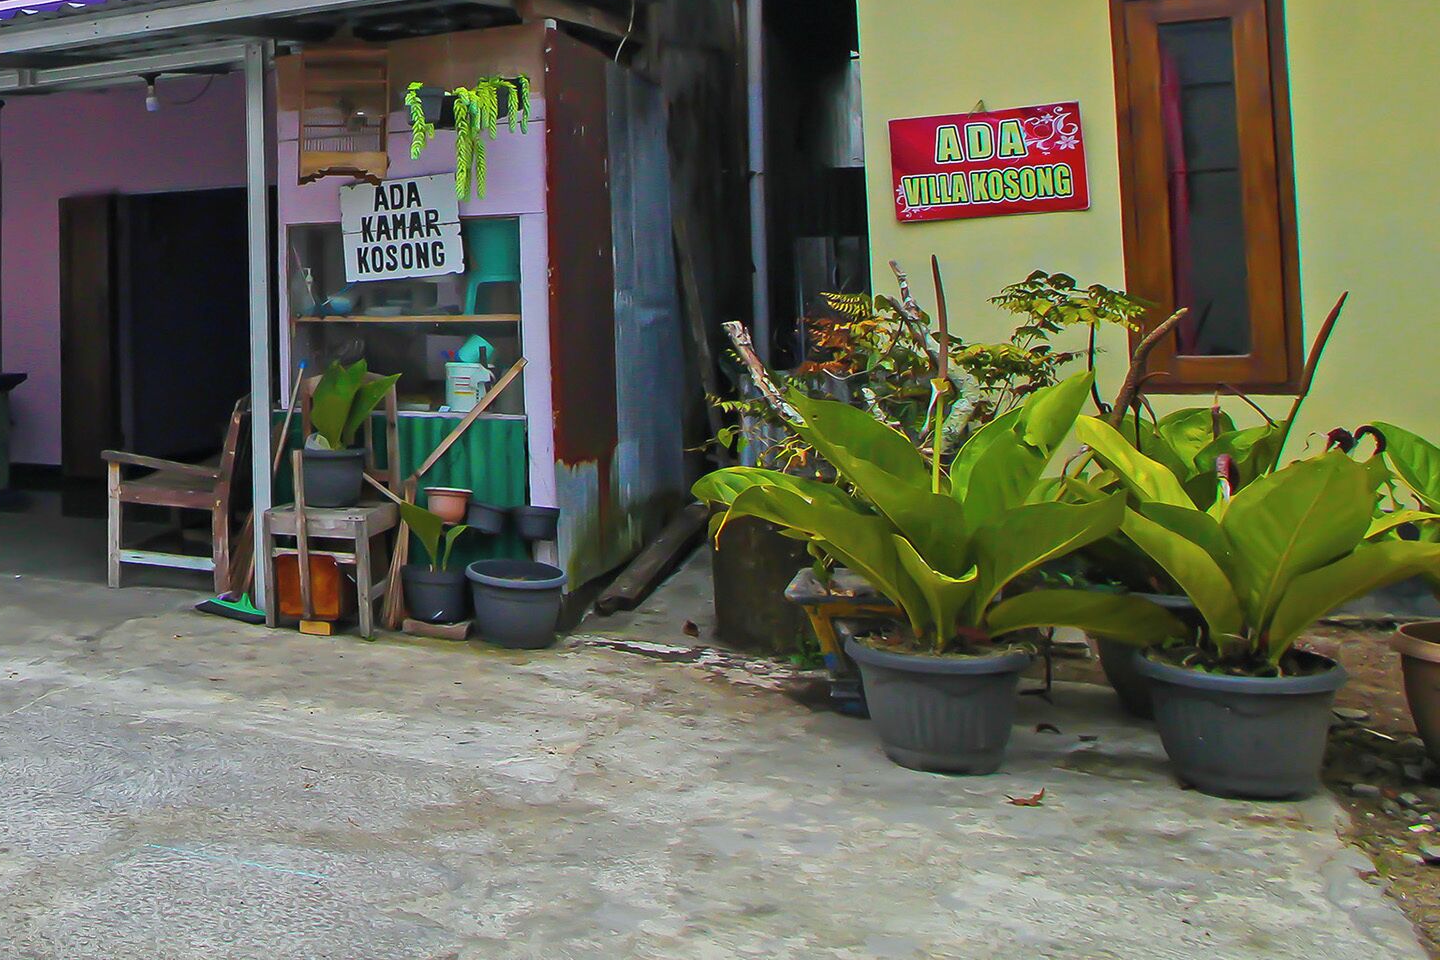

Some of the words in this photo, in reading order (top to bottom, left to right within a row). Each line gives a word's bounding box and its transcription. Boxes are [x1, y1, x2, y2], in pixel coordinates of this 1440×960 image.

[936, 120, 1027, 163] ADA
[374, 182, 421, 212] ADA
[901, 172, 970, 207] VILLA
[970, 164, 1073, 203] KOSONG
[361, 209, 441, 243] KAMAR
[356, 241, 445, 274] KOSONG
